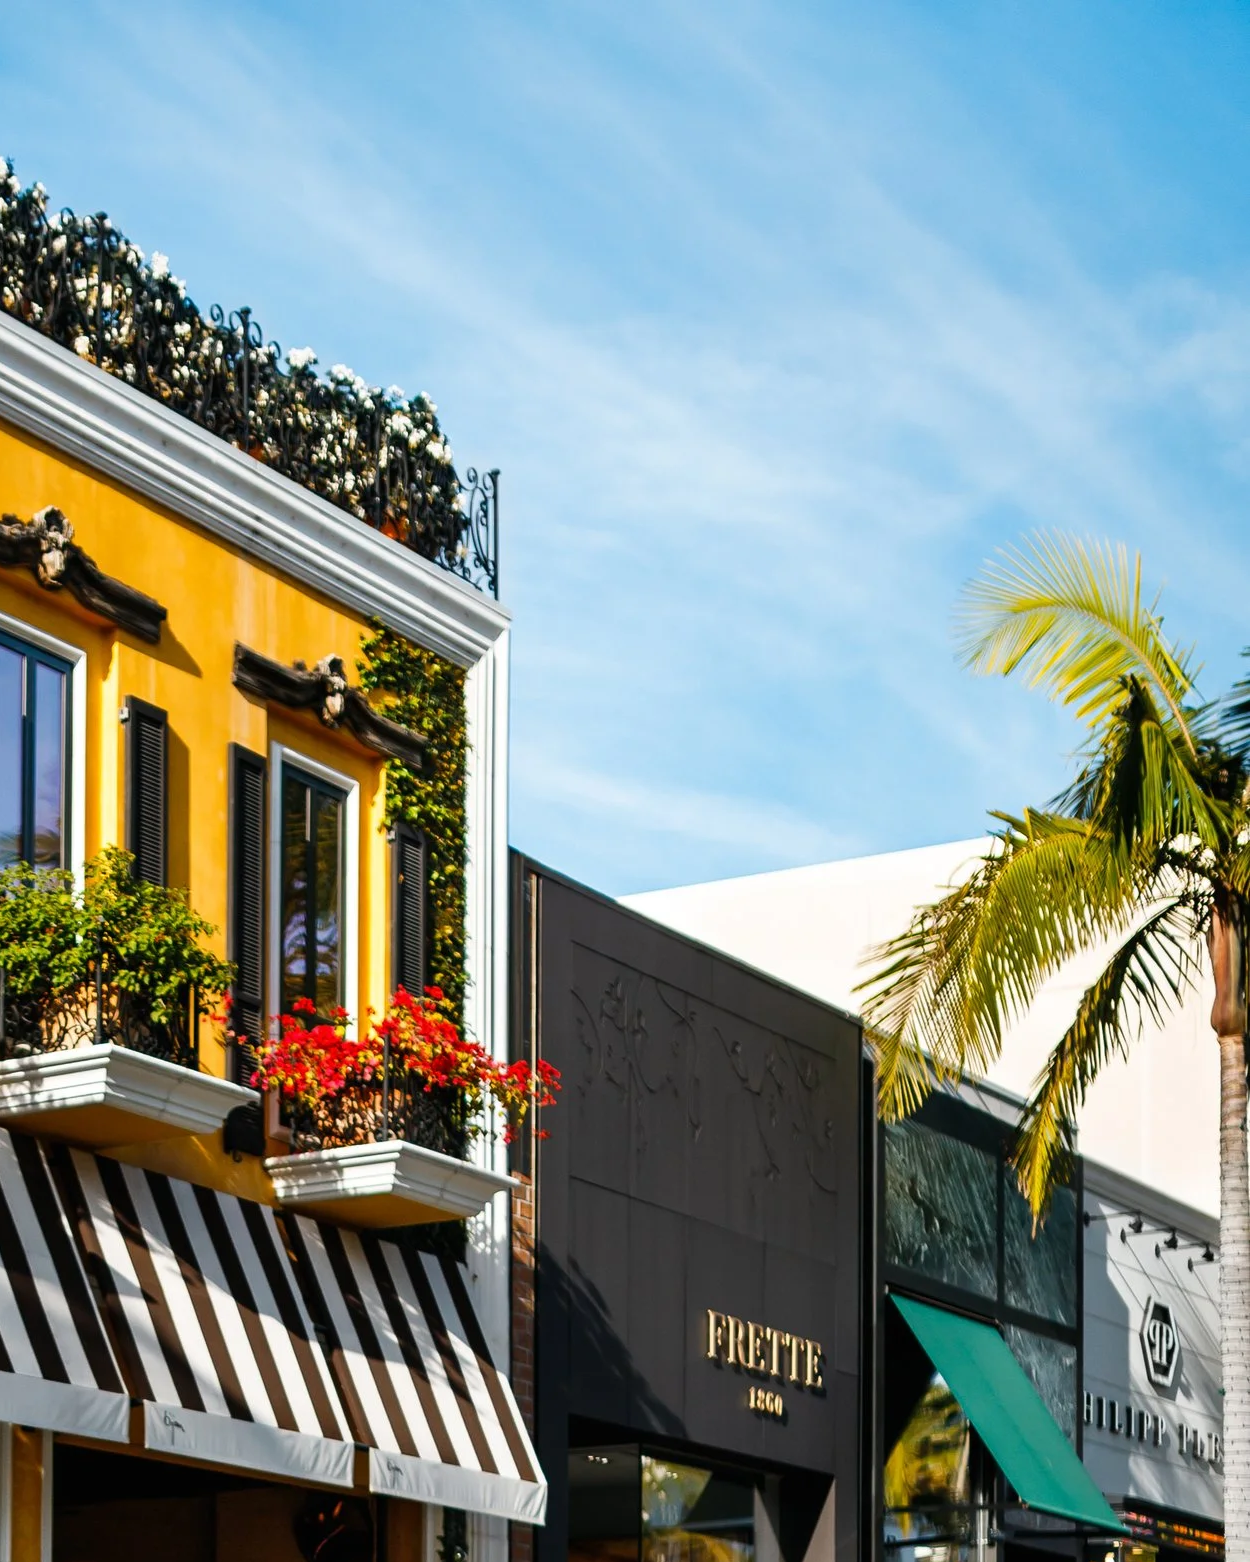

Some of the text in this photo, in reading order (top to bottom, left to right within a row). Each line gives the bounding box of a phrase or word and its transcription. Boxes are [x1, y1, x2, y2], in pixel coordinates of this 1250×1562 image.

[707, 1309, 823, 1389] FRETTE
[749, 1386, 783, 1416] 1860
[1083, 1390, 1166, 1446] HILIPP
